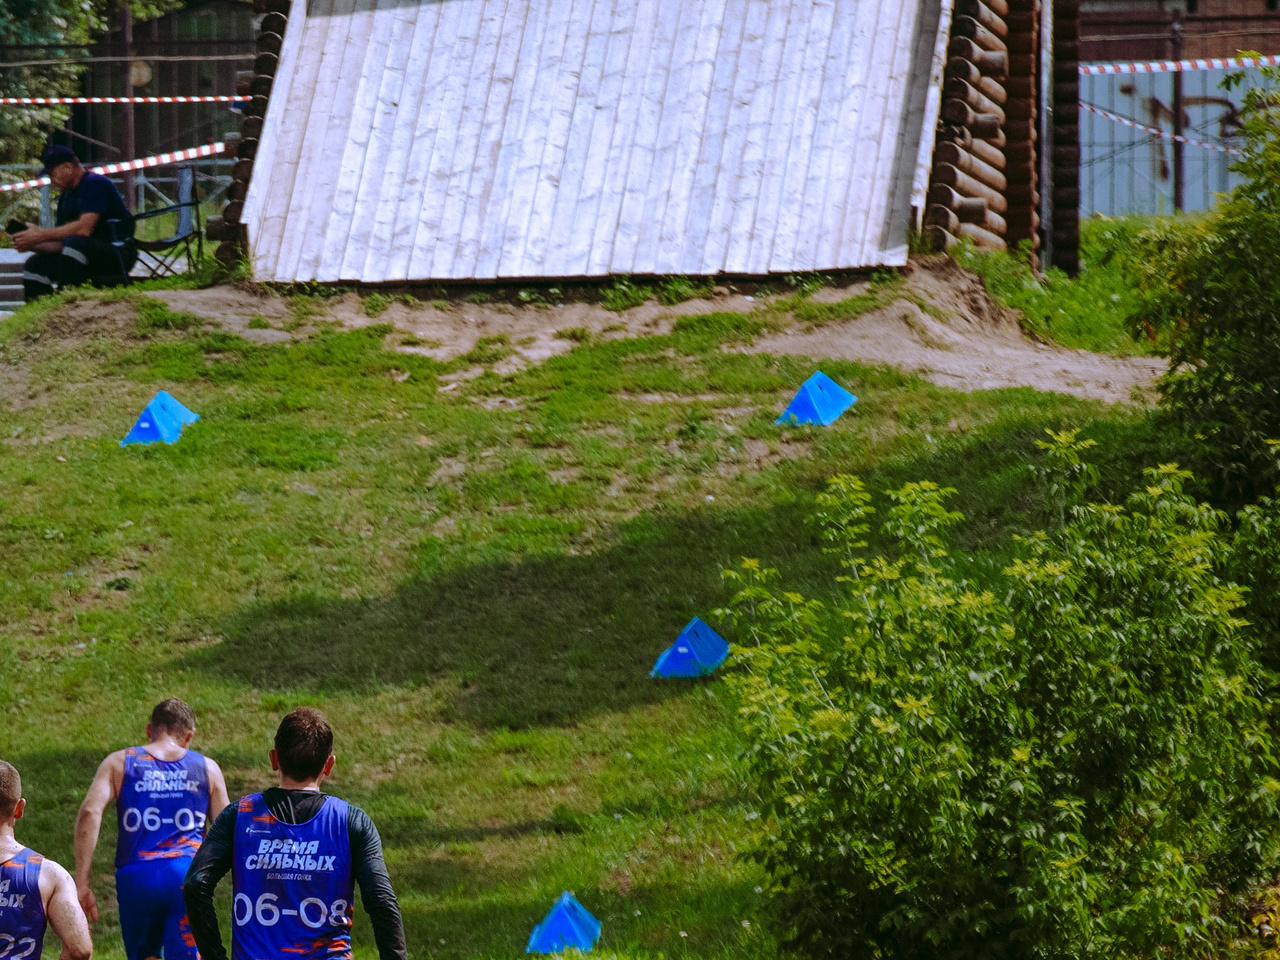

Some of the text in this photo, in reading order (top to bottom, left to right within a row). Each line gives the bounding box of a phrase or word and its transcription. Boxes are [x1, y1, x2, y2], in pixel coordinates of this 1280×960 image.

[143, 770, 188, 780] ВРЕМЯ
[135, 780, 200, 792] СИЛЬНЫХ
[258, 839, 320, 854] ВРЕМЯ
[245, 854, 336, 871] СИЛЬНЫХ
[234, 893, 348, 928] 06-08
